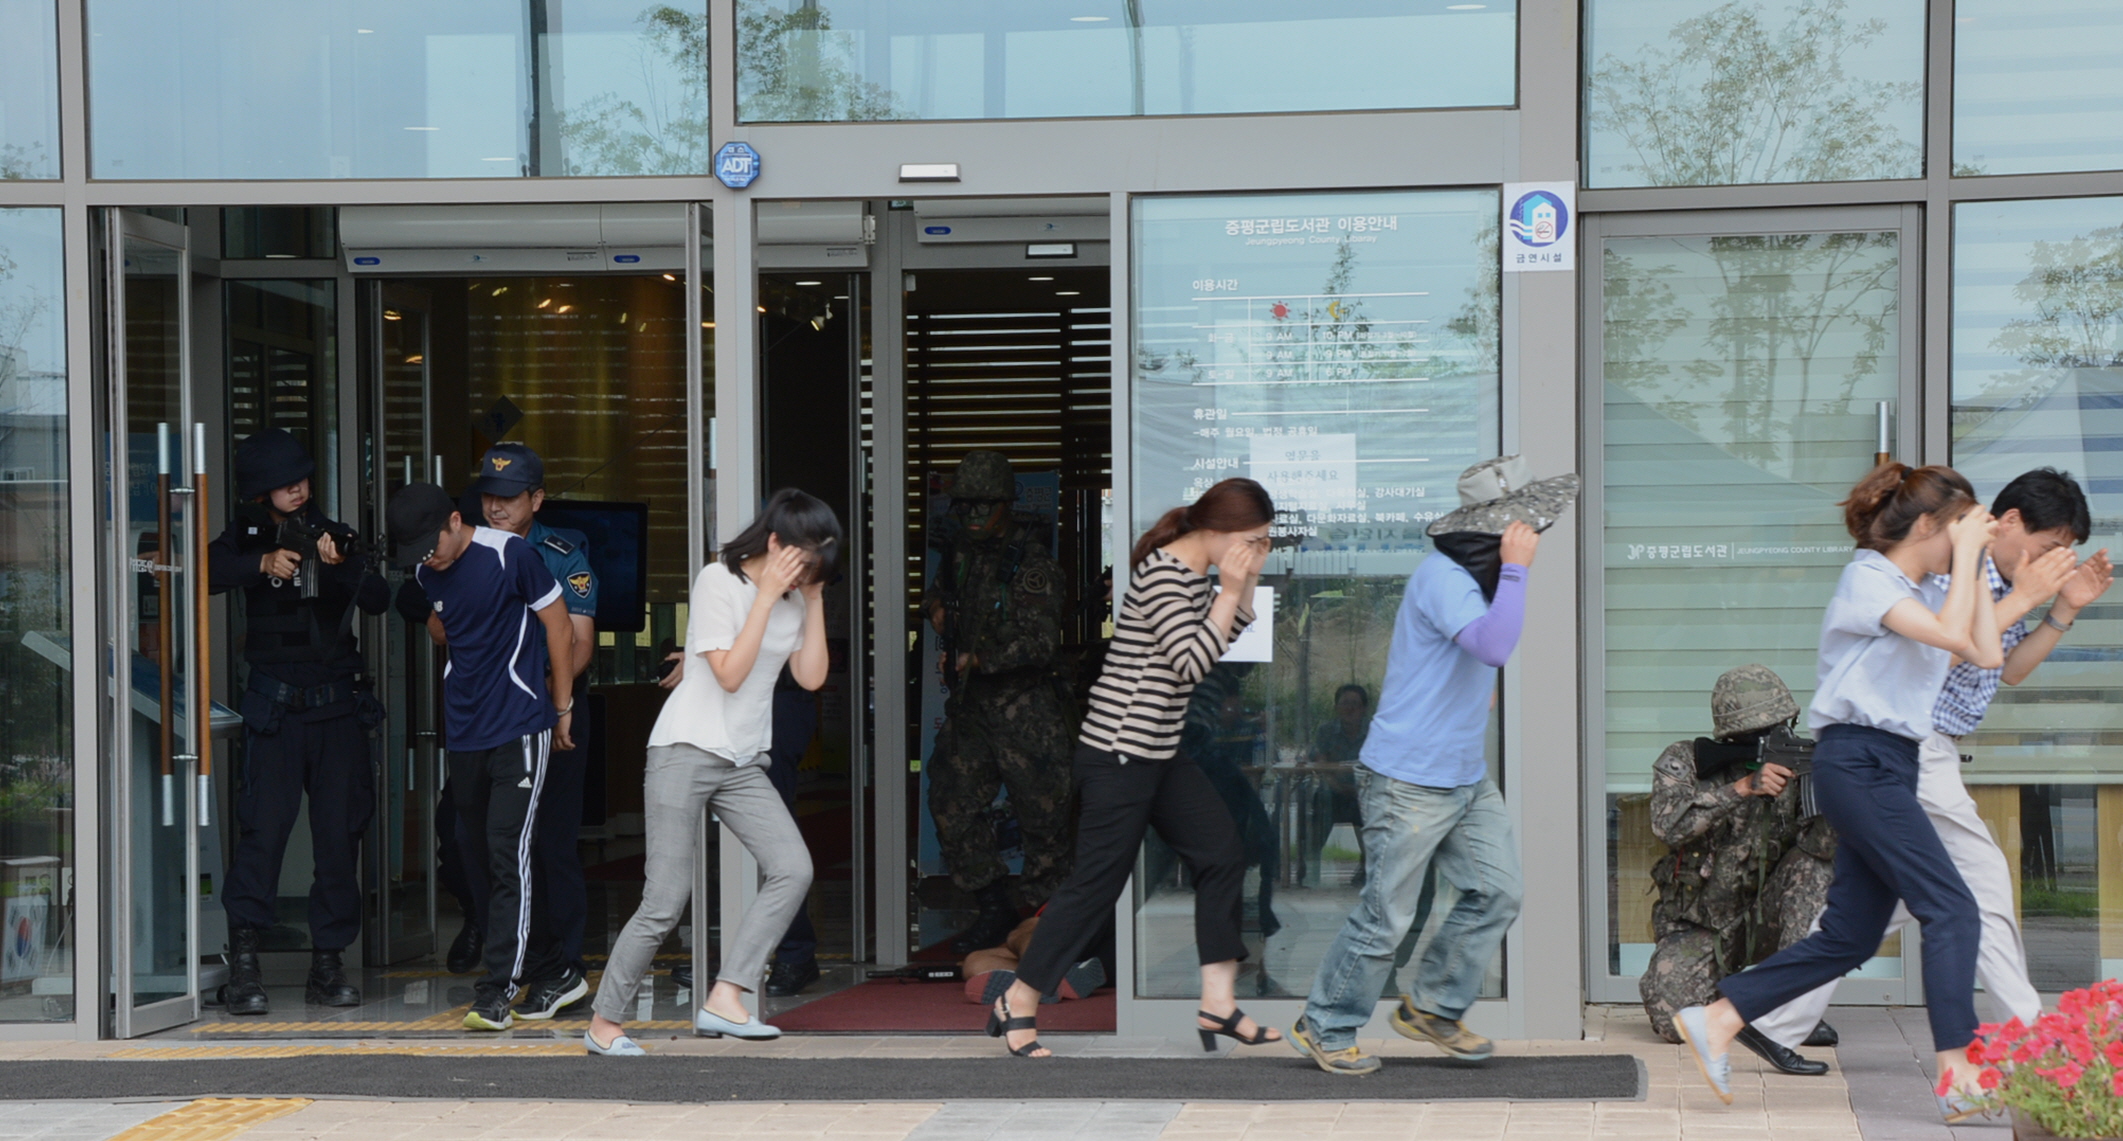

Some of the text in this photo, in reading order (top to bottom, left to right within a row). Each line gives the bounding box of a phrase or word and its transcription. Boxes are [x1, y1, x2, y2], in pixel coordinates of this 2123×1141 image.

[721, 157, 752, 173] ADT
[1225, 215, 1398, 236] 증평군립도서관 이용안내
[1245, 236, 1305, 246] Jeungpyeong
[1309, 235, 1340, 244] County
[1516, 253, 1562, 264] 금연시설
[1192, 279, 1239, 291] 이용시간
[1266, 332, 1293, 341] 9 AM
[1323, 330, 1352, 340] 10 PM
[1266, 351, 1294, 360] 9 AM
[1325, 348, 1352, 358] 9 PM
[1266, 368, 1293, 378] 9 AM
[1325, 367, 1352, 377] 6 PM
[1194, 408, 1228, 420] 휴관일
[1193, 428, 1220, 438] -매주
[1262, 427, 1283, 437] 법정
[1287, 426, 1318, 437] 공휴일
[1193, 457, 1239, 470] 시설안내
[1193, 477, 1214, 489] 옥상
[1375, 486, 1425, 498] 강사대기실
[1306, 513, 1371, 523] 다문화자료실,
[1647, 544, 1728, 560] 증평군립도서관
[1737, 545, 1854, 555] JEUNGPYEONG COUNTY LIBRARY
